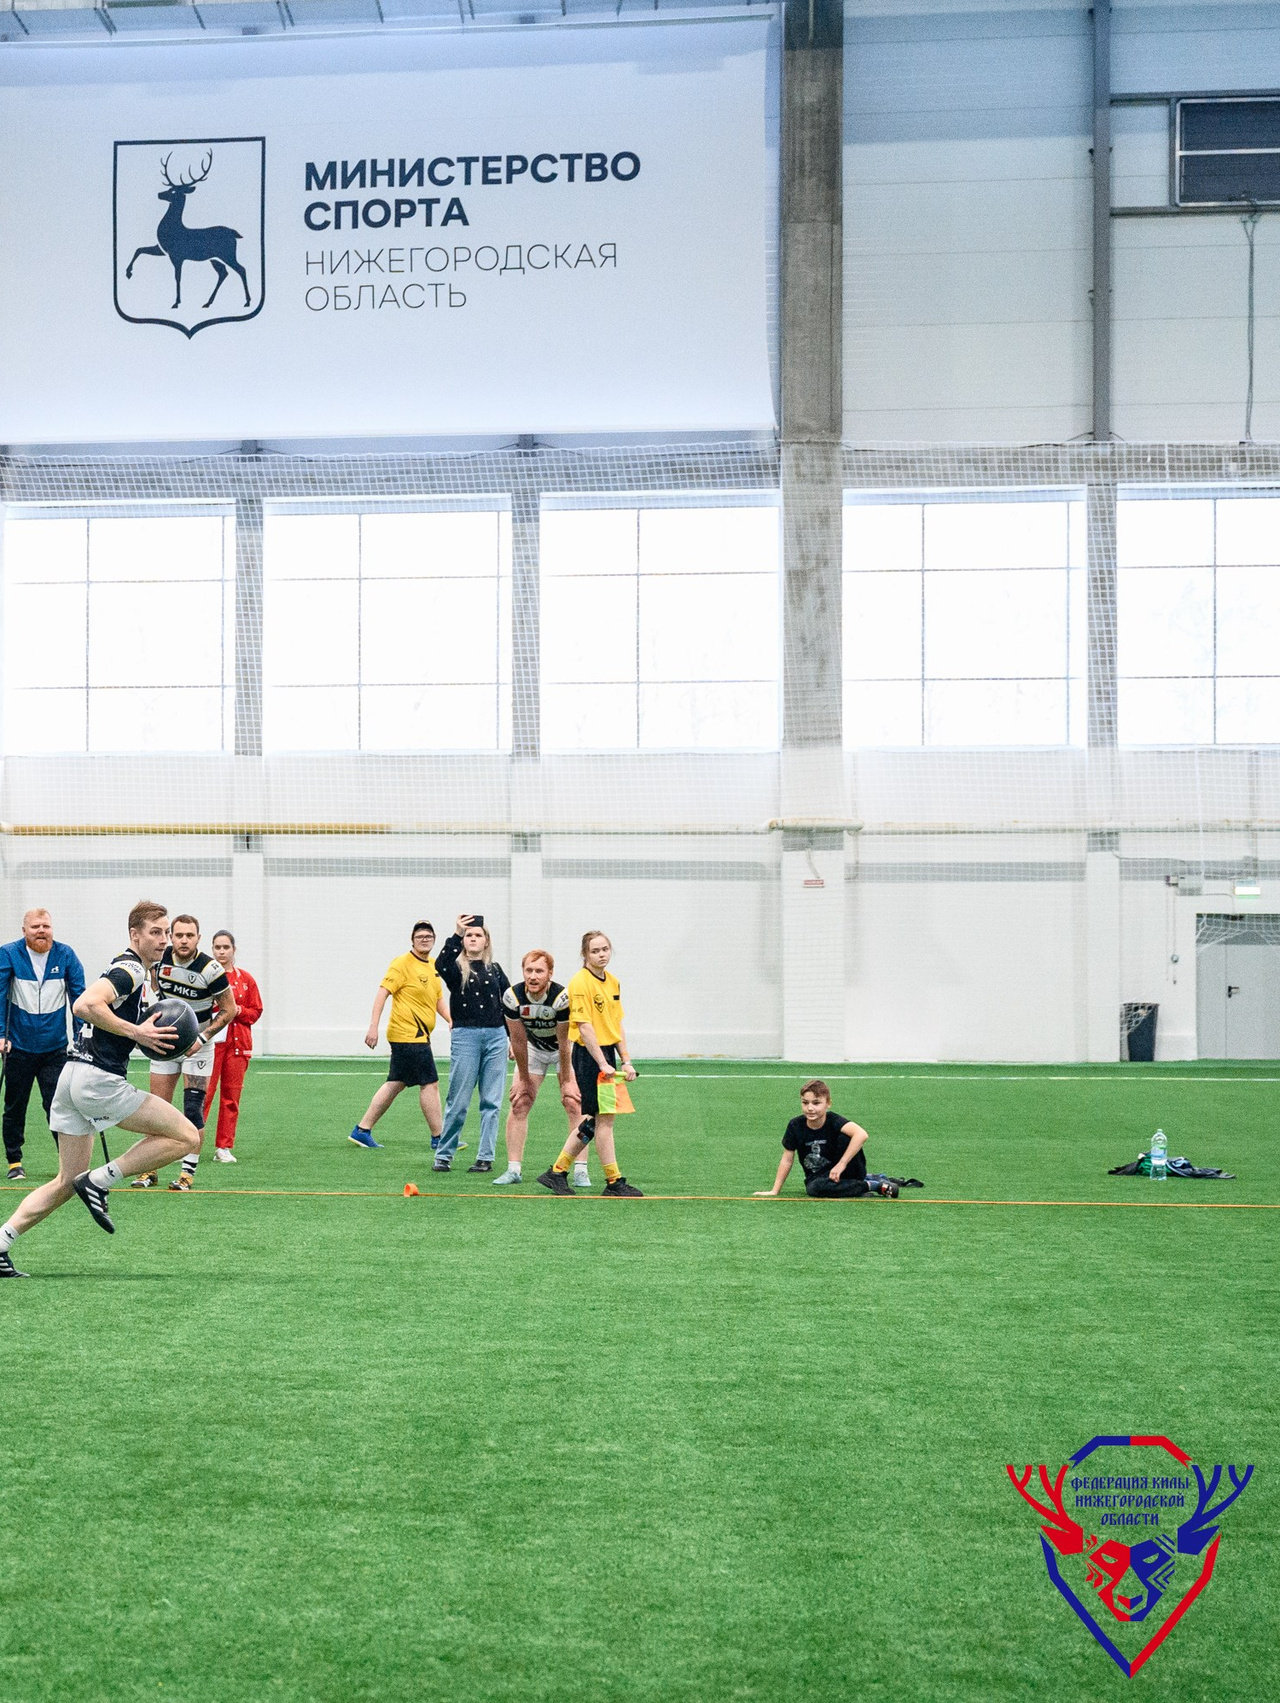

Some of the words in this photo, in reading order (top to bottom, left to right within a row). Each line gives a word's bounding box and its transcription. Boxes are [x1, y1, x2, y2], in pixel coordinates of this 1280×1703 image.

[304, 150, 642, 191] МИНИСТЕРСТВО
[303, 196, 471, 231] СПОРТА
[305, 242, 618, 276] НИЖЕГОРОДСКАЯ
[304, 282, 468, 312] ОБЛАСТЬ
[173, 985, 198, 997] МКБ
